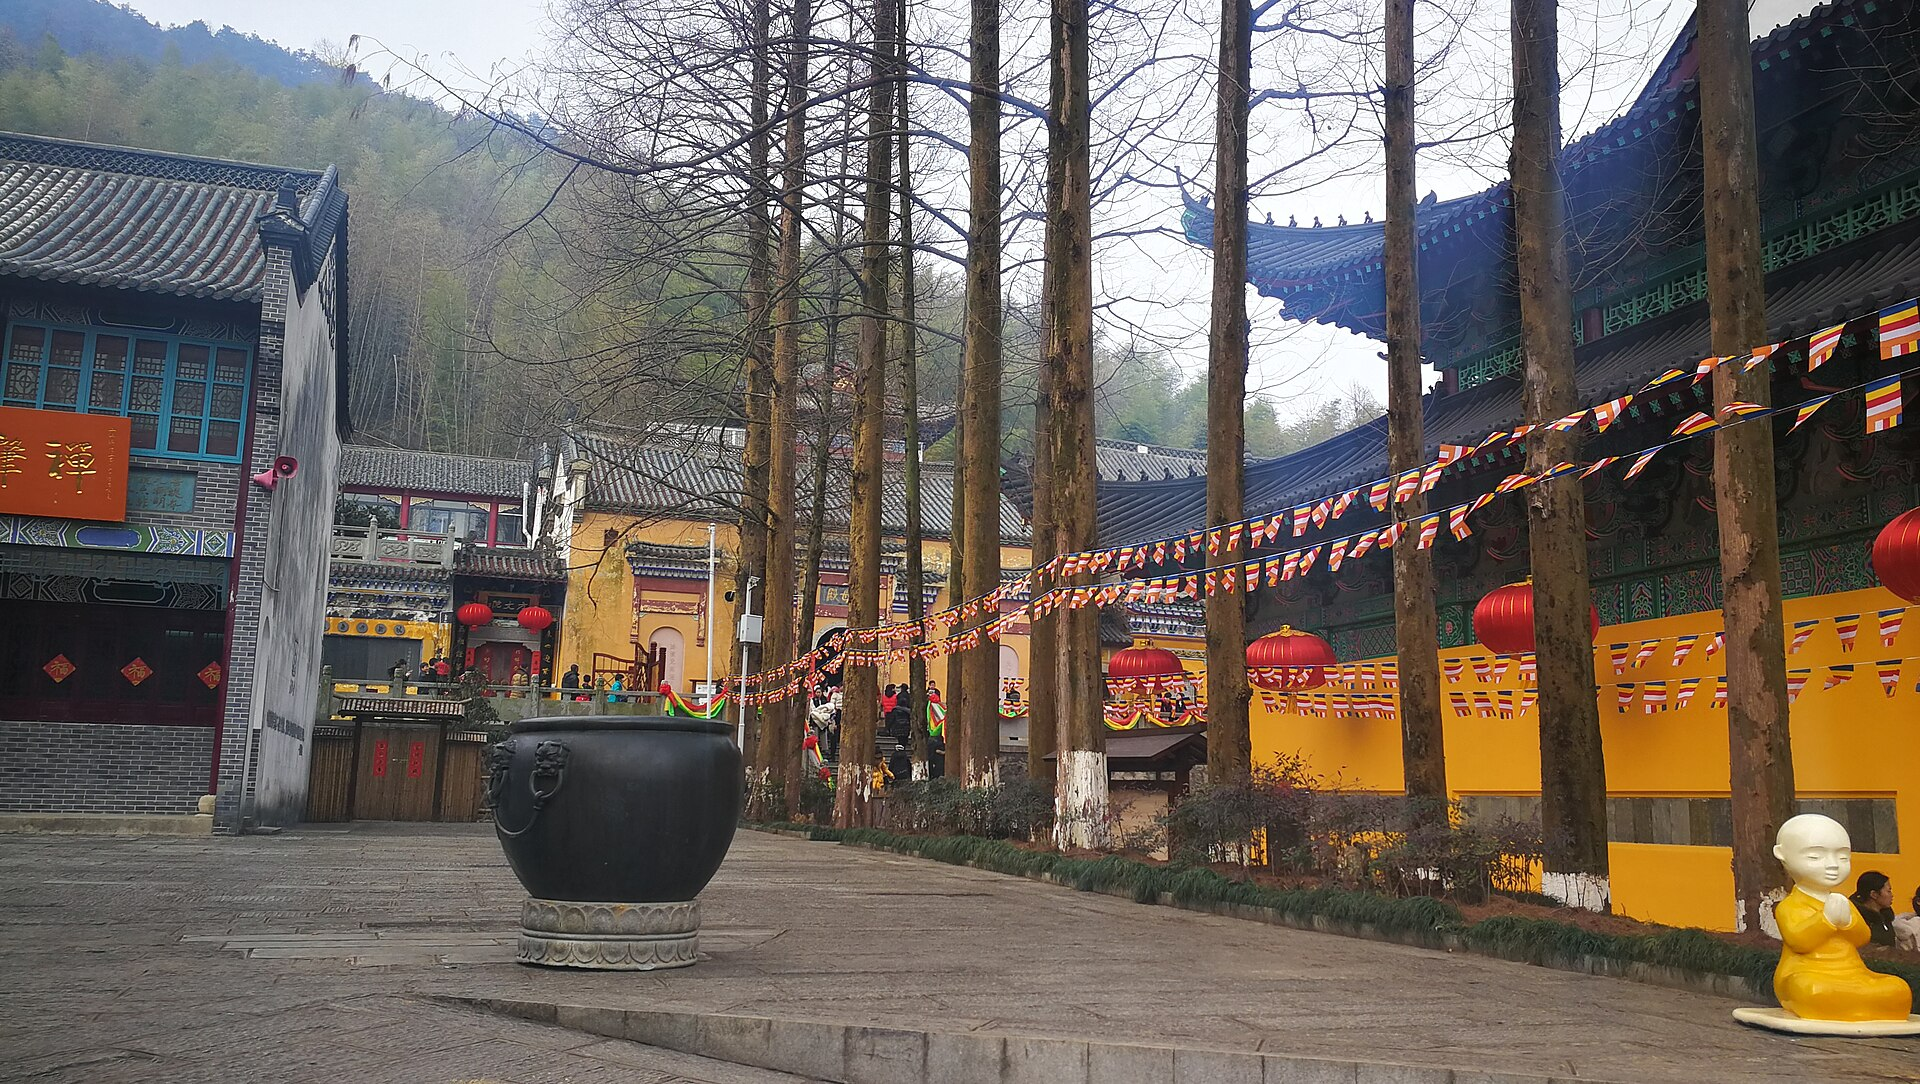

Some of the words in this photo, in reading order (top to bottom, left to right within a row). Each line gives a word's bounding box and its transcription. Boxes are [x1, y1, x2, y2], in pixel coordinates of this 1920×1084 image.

[50, 661, 70, 676] 福
[128, 664, 147, 678] 福
[204, 668, 221, 682] 福
